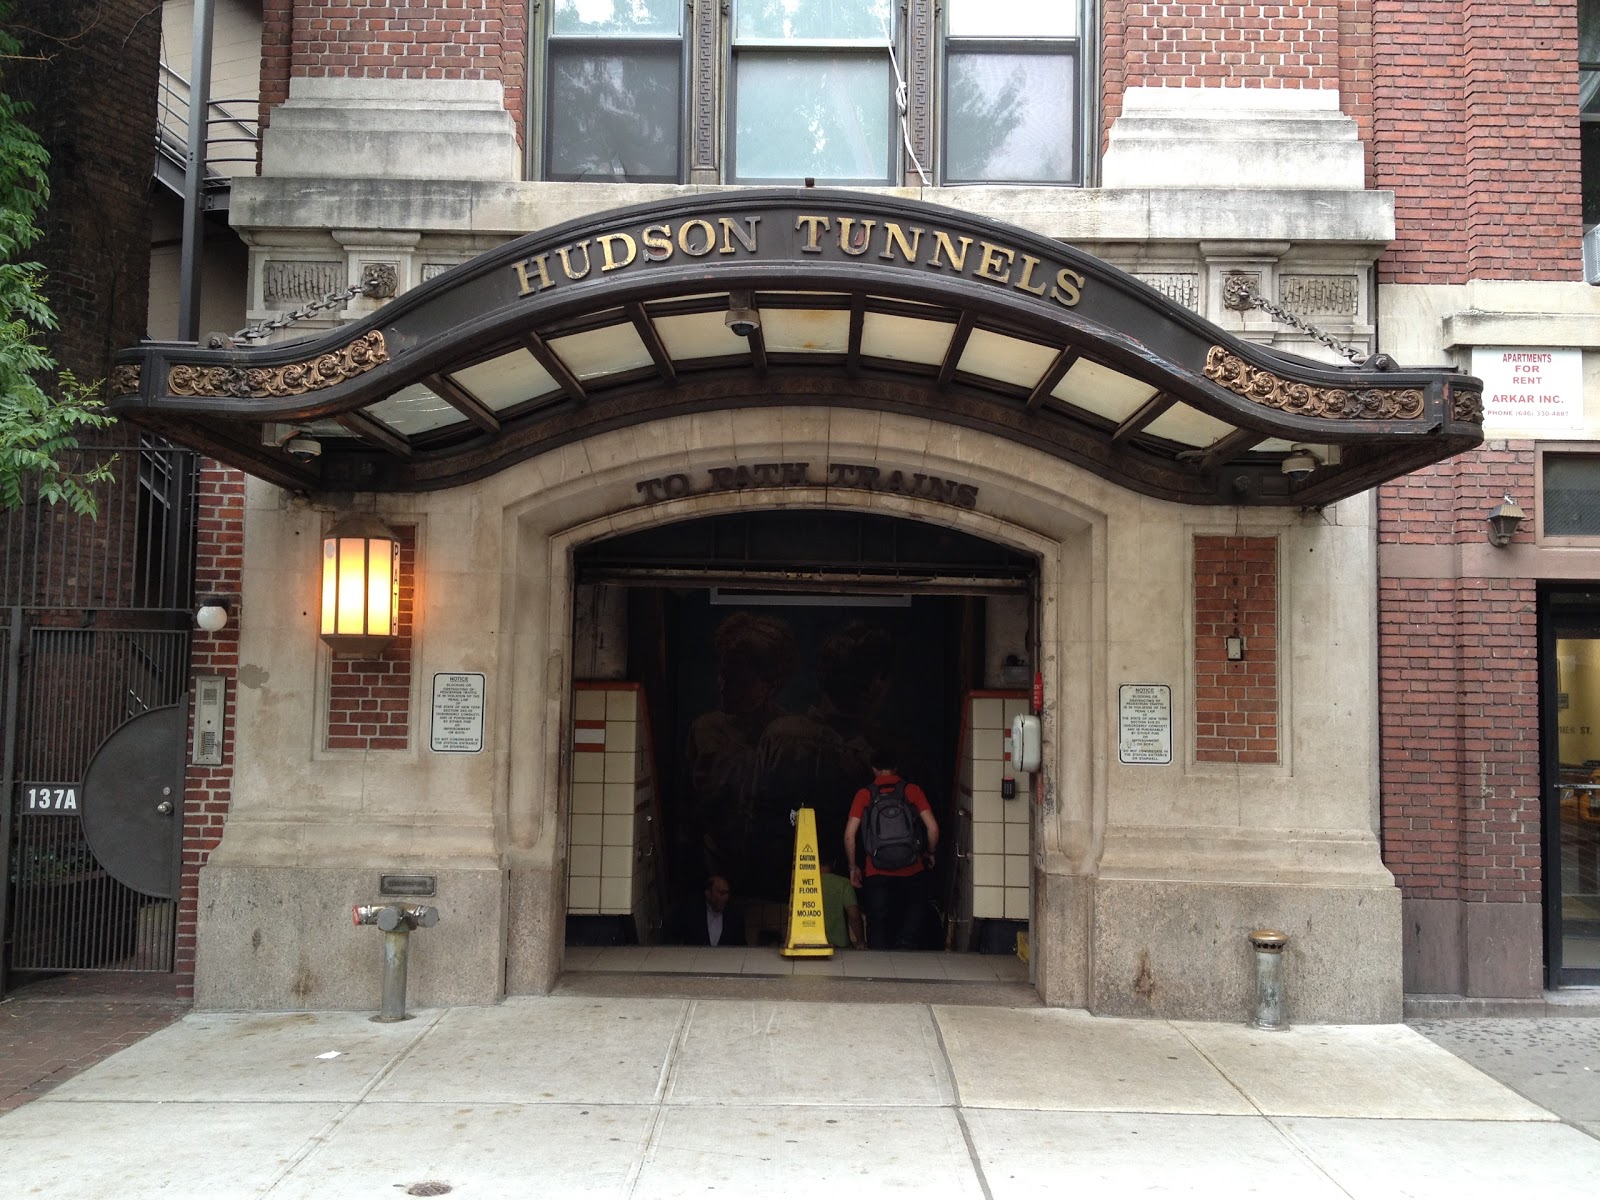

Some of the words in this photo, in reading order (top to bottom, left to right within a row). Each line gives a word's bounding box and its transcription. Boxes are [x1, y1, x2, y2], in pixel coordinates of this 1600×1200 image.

[510, 216, 761, 298] HUDSON
[795, 215, 1087, 307] TUNNELS
[1502, 354, 1552, 363] APARTMENTS
[1492, 395, 1534, 403] ARKAR
[636, 473, 690, 502] TO
[707, 462, 810, 492] PATH
[829, 463, 980, 509] TRAINS
[29, 788, 76, 809] 137A
